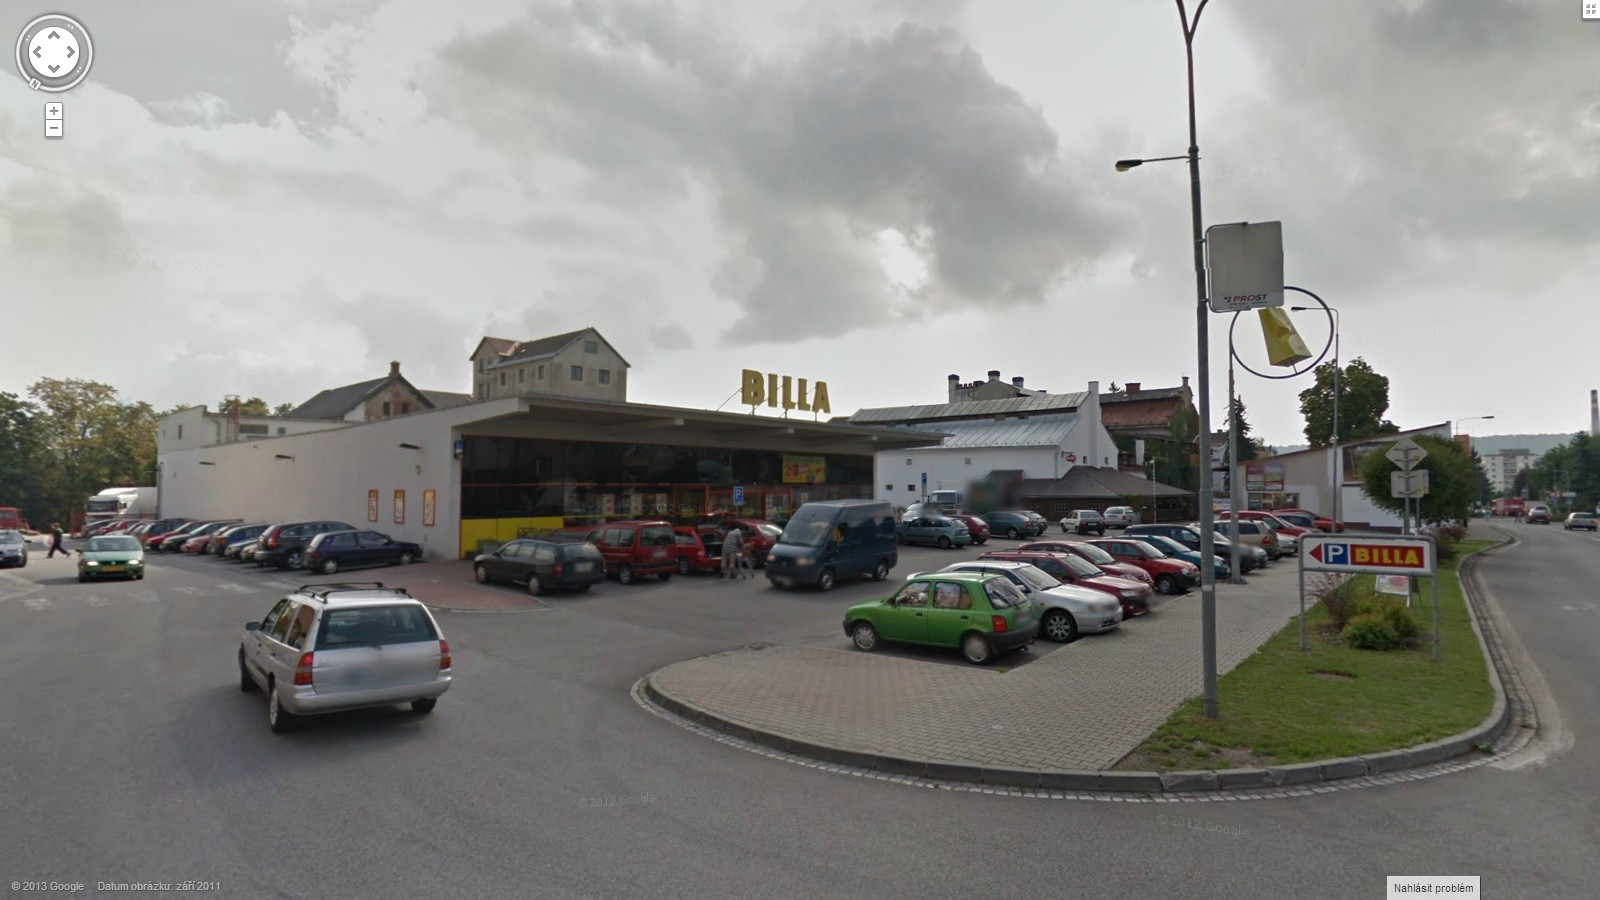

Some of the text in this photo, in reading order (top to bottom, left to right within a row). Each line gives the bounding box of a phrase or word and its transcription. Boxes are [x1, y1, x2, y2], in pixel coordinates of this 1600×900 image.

[1233, 294, 1268, 302] PROST
[741, 369, 831, 414] BILLA
[1328, 545, 1419, 565] P BILLA
